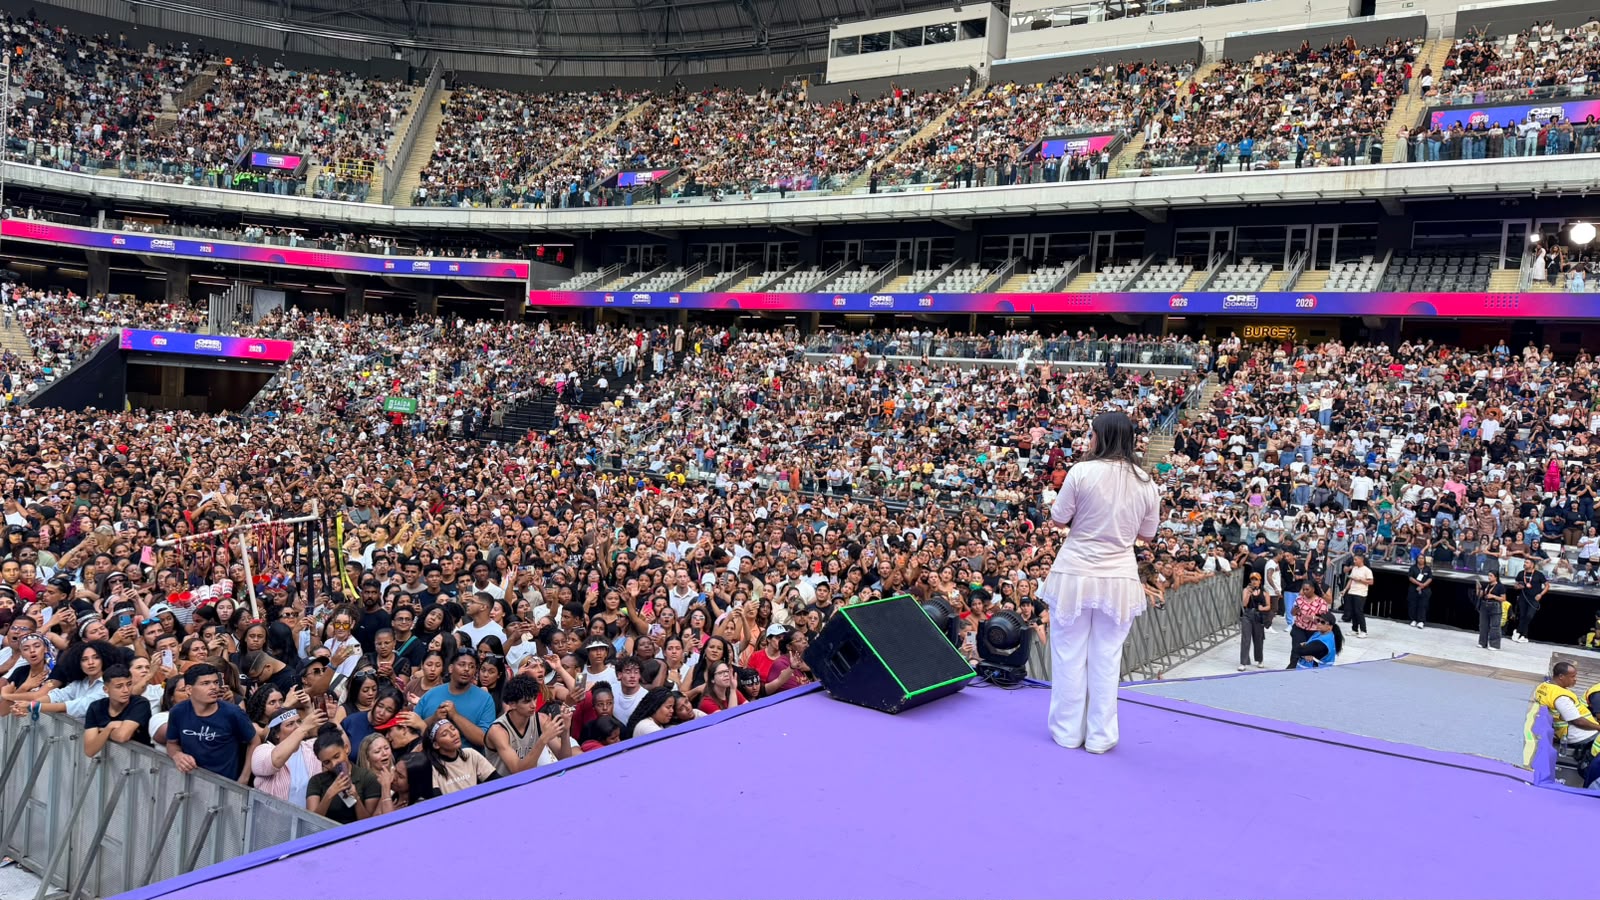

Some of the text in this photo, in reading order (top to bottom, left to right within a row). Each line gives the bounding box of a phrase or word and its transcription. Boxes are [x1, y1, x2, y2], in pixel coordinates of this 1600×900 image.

[1530, 106, 1562, 114] ORE
[1171, 298, 1188, 307] 2026
[1295, 298, 1314, 308] 2026
[279, 710, 295, 720] 100%
